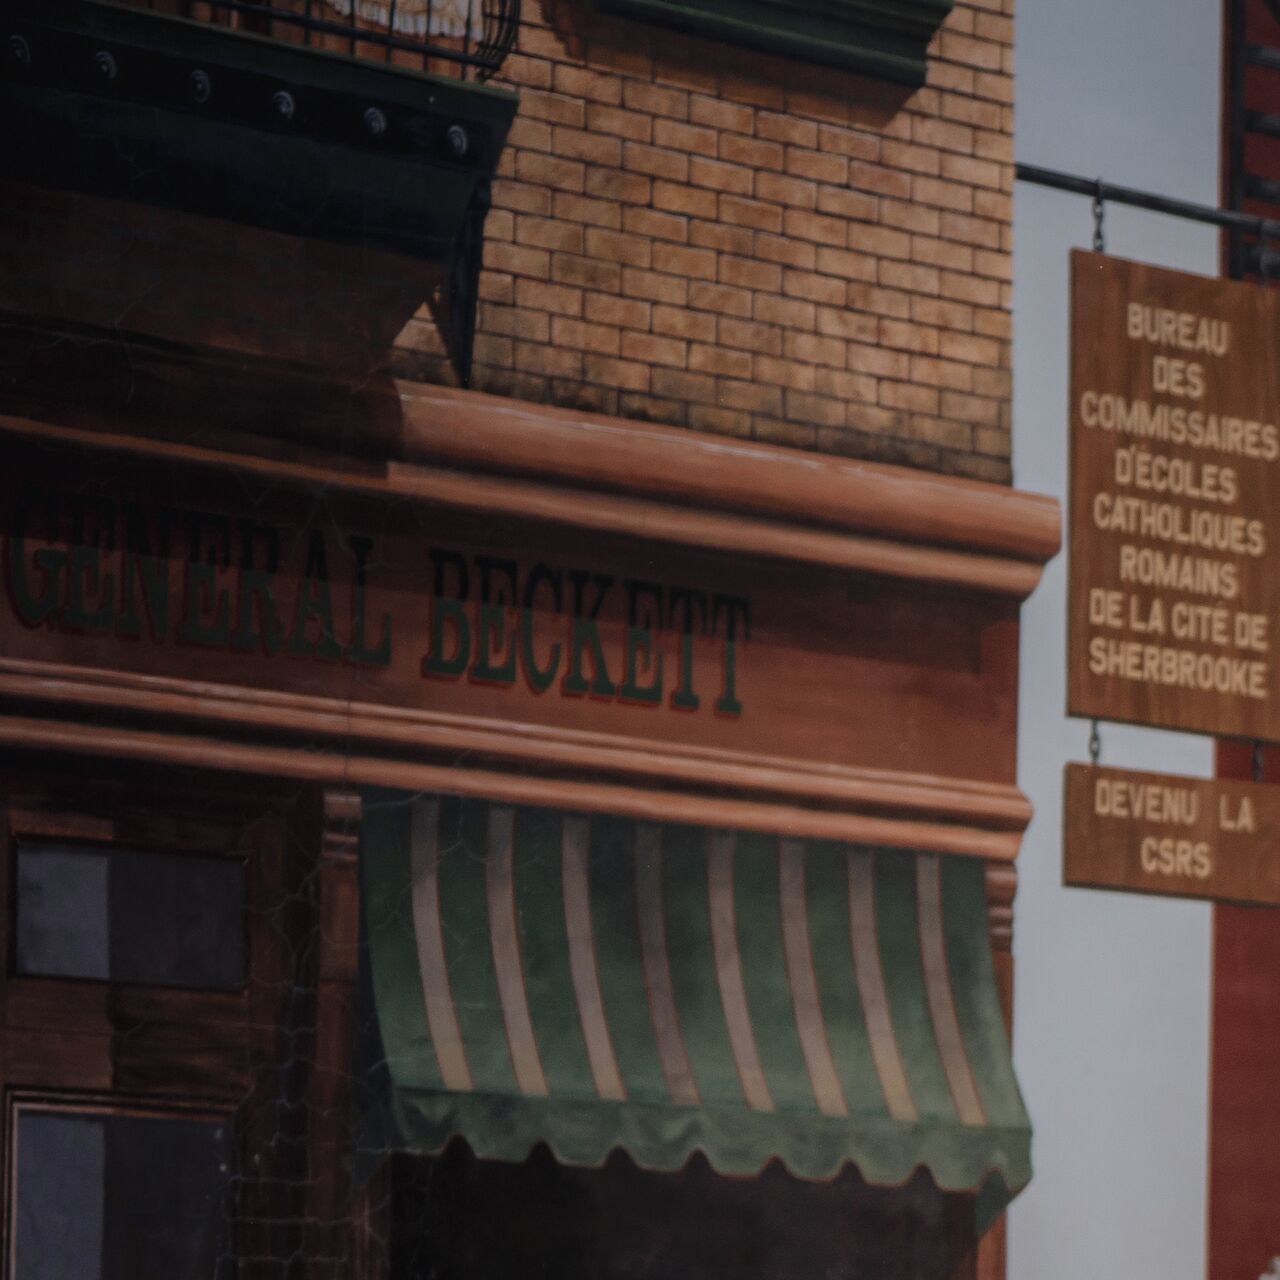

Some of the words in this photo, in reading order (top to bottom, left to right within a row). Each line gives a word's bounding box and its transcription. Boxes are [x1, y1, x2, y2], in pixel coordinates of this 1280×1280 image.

[1127, 302, 1231, 357] BUREAU
[1153, 356, 1205, 400] DES
[1081, 390, 1279, 462] COMMISSAIRES
[1094, 492, 1265, 558] CATHOLIQUES
[3, 486, 390, 667] GENERAL
[422, 548, 751, 716] BECKETT
[1121, 544, 1239, 599] ROMAINS
[1090, 587, 1123, 628] DE
[1130, 594, 1164, 634] LA
[1234, 611, 1268, 652] DE
[1090, 636, 1267, 699] SHERBROOKE
[1095, 778, 1199, 826] DEVENU
[1219, 794, 1256, 833] LA
[1141, 836, 1212, 879] CSRS
